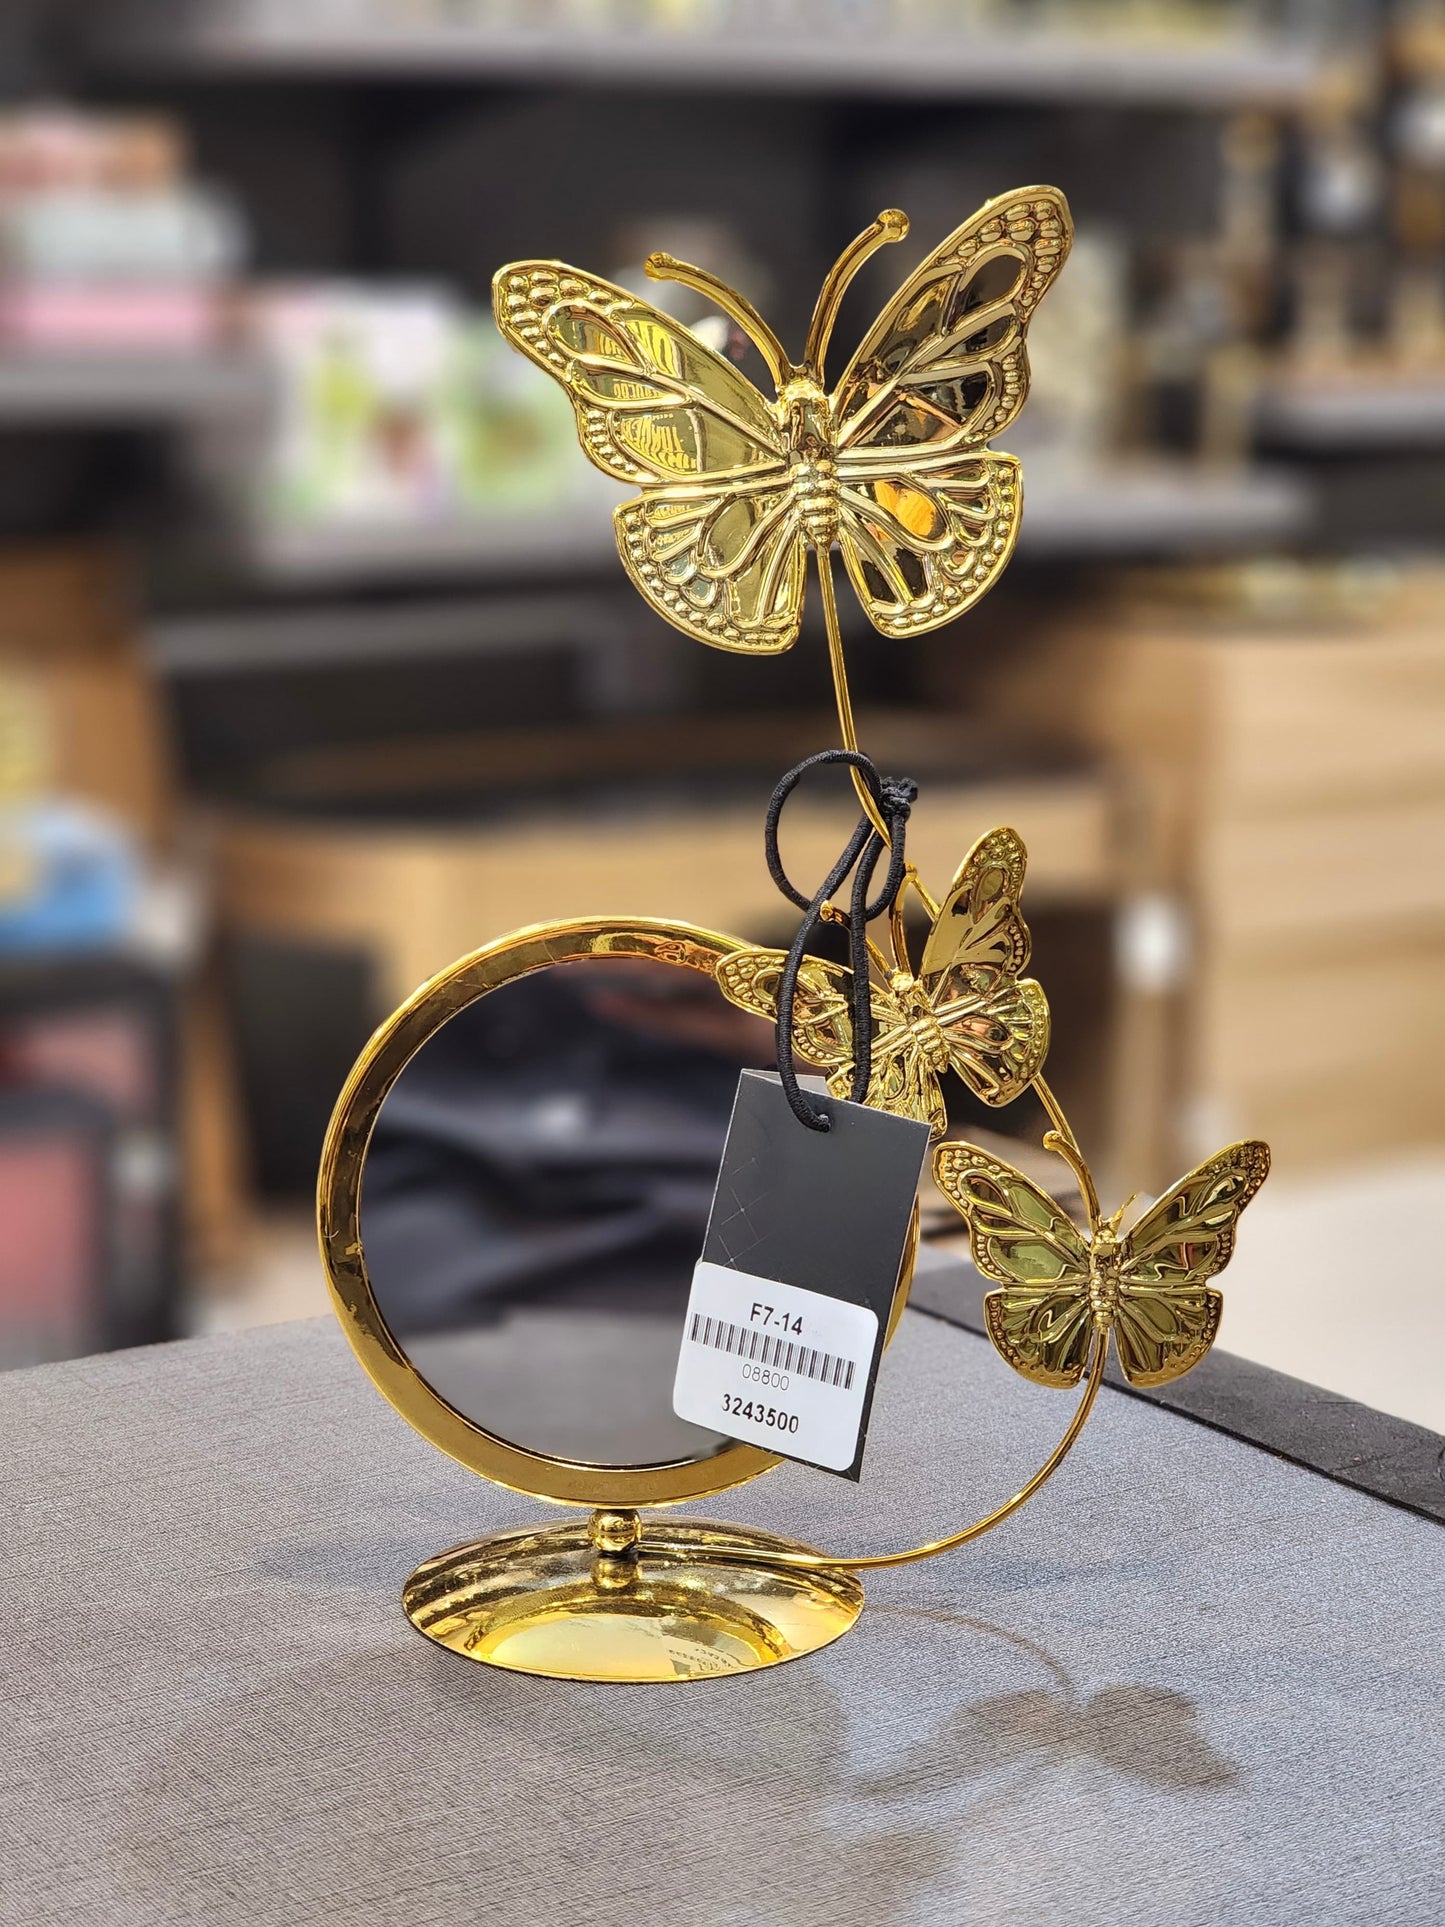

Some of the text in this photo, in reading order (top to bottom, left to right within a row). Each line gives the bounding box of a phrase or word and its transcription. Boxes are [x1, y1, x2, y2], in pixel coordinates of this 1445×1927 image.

[750, 1303, 803, 1336] F7-14
[742, 1363, 790, 1391] 08800
[722, 1393, 799, 1434] 3243500
